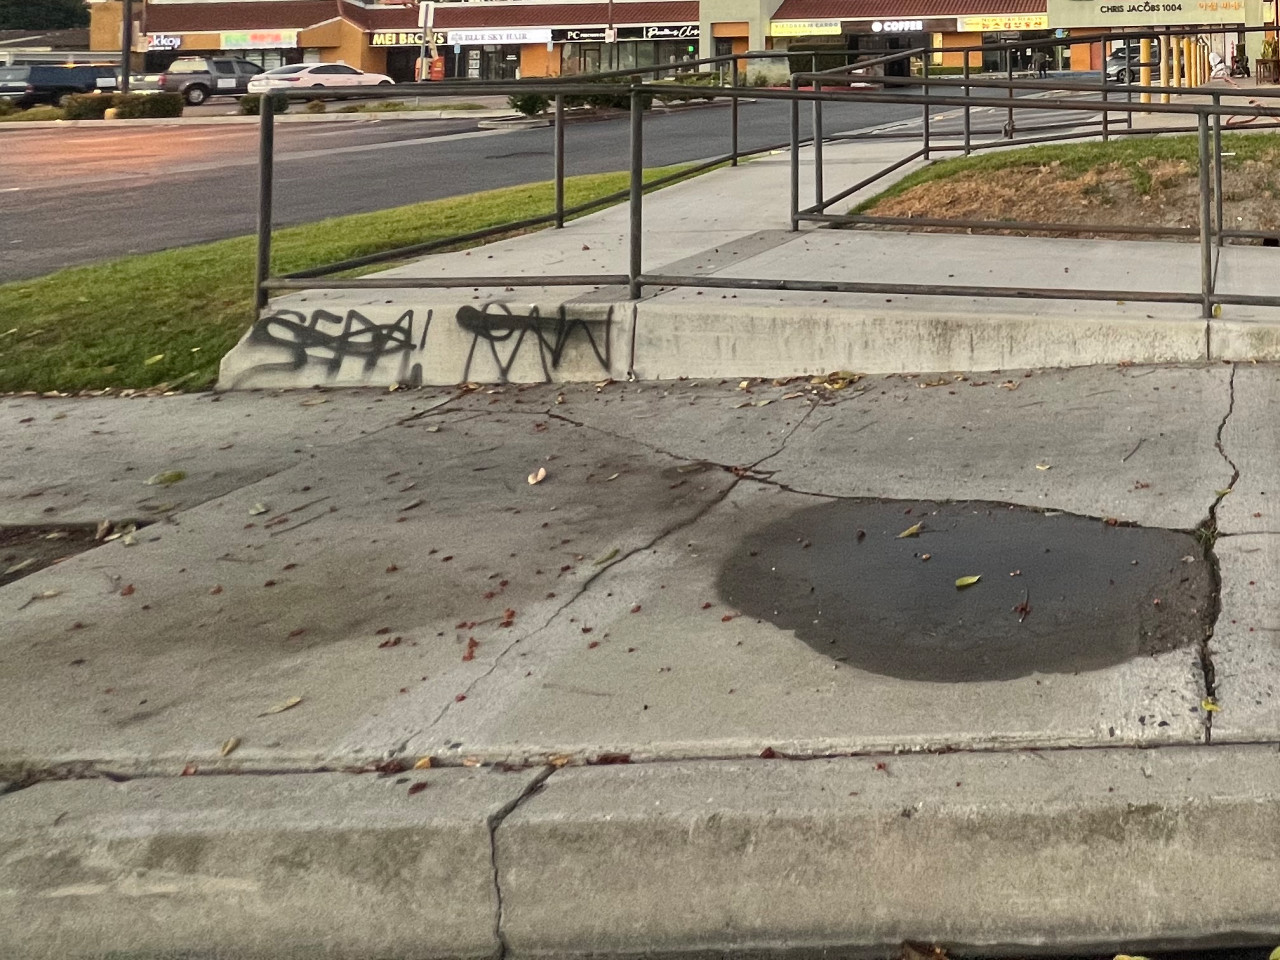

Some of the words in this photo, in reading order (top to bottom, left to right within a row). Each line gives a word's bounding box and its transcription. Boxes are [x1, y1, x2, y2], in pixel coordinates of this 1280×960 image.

[1100, 5, 1124, 13] CHRIS
[1126, 3, 1160, 13] JACOBS
[1162, 4, 1183, 12] 1004
[883, 20, 923, 31] COFFEE
[372, 33, 396, 45] MEI
